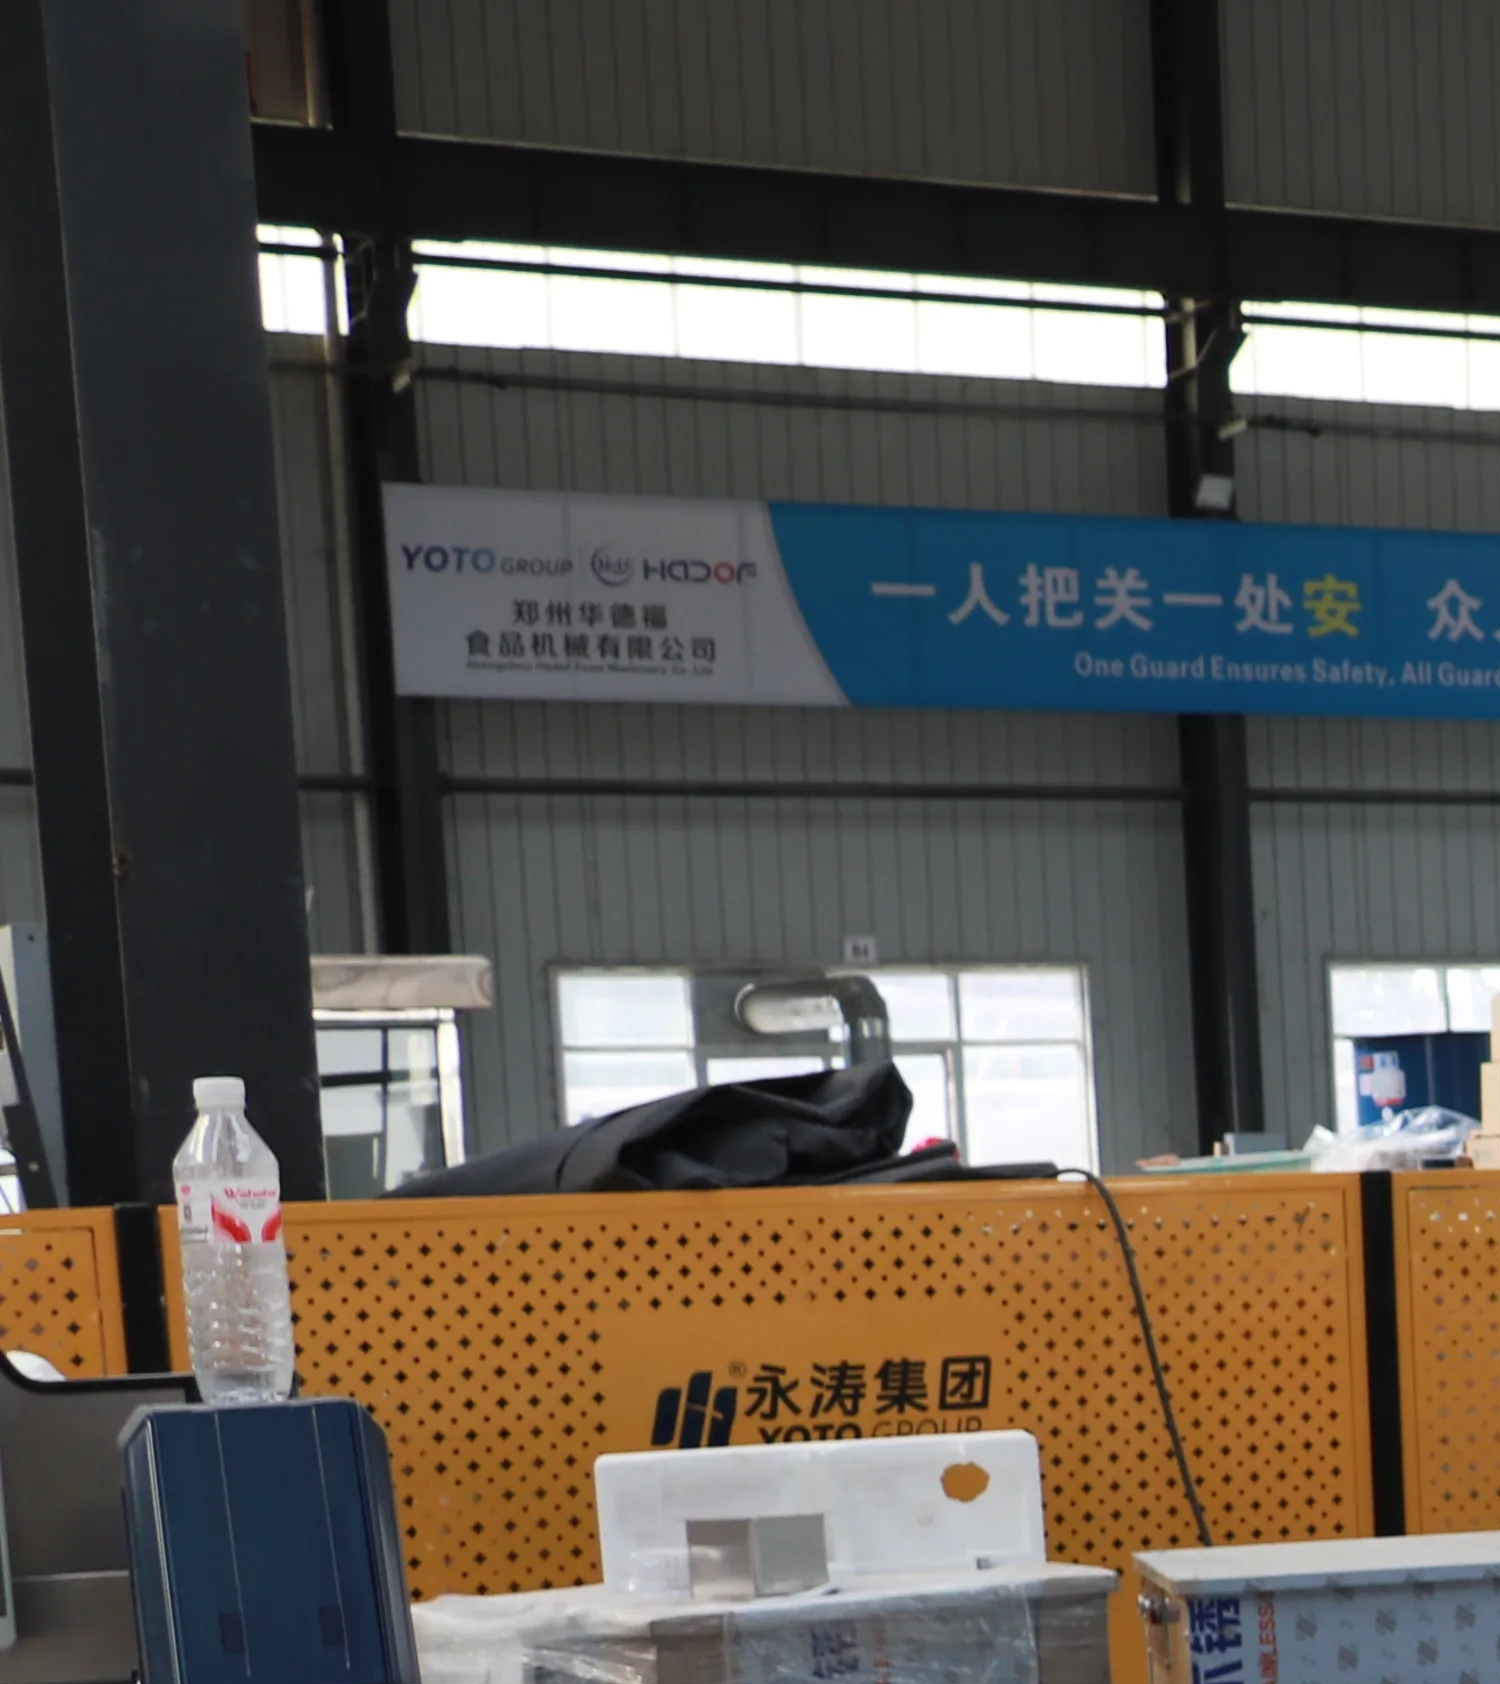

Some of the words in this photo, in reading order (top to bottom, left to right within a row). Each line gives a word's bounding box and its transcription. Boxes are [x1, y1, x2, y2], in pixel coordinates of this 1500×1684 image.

[400, 543, 497, 574] YOTO
[500, 557, 574, 577] GROUP
[512, 599, 668, 630] 郑州华德福
[870, 563, 1360, 637] 一人把关一处安
[465, 629, 717, 662] 食品机械有限公司
[1074, 652, 1124, 678] One
[1130, 653, 1205, 680] Guard
[1211, 656, 1307, 684] Ensures
[1401, 661, 1432, 686] All
[744, 1355, 992, 1419] 永涛集团
